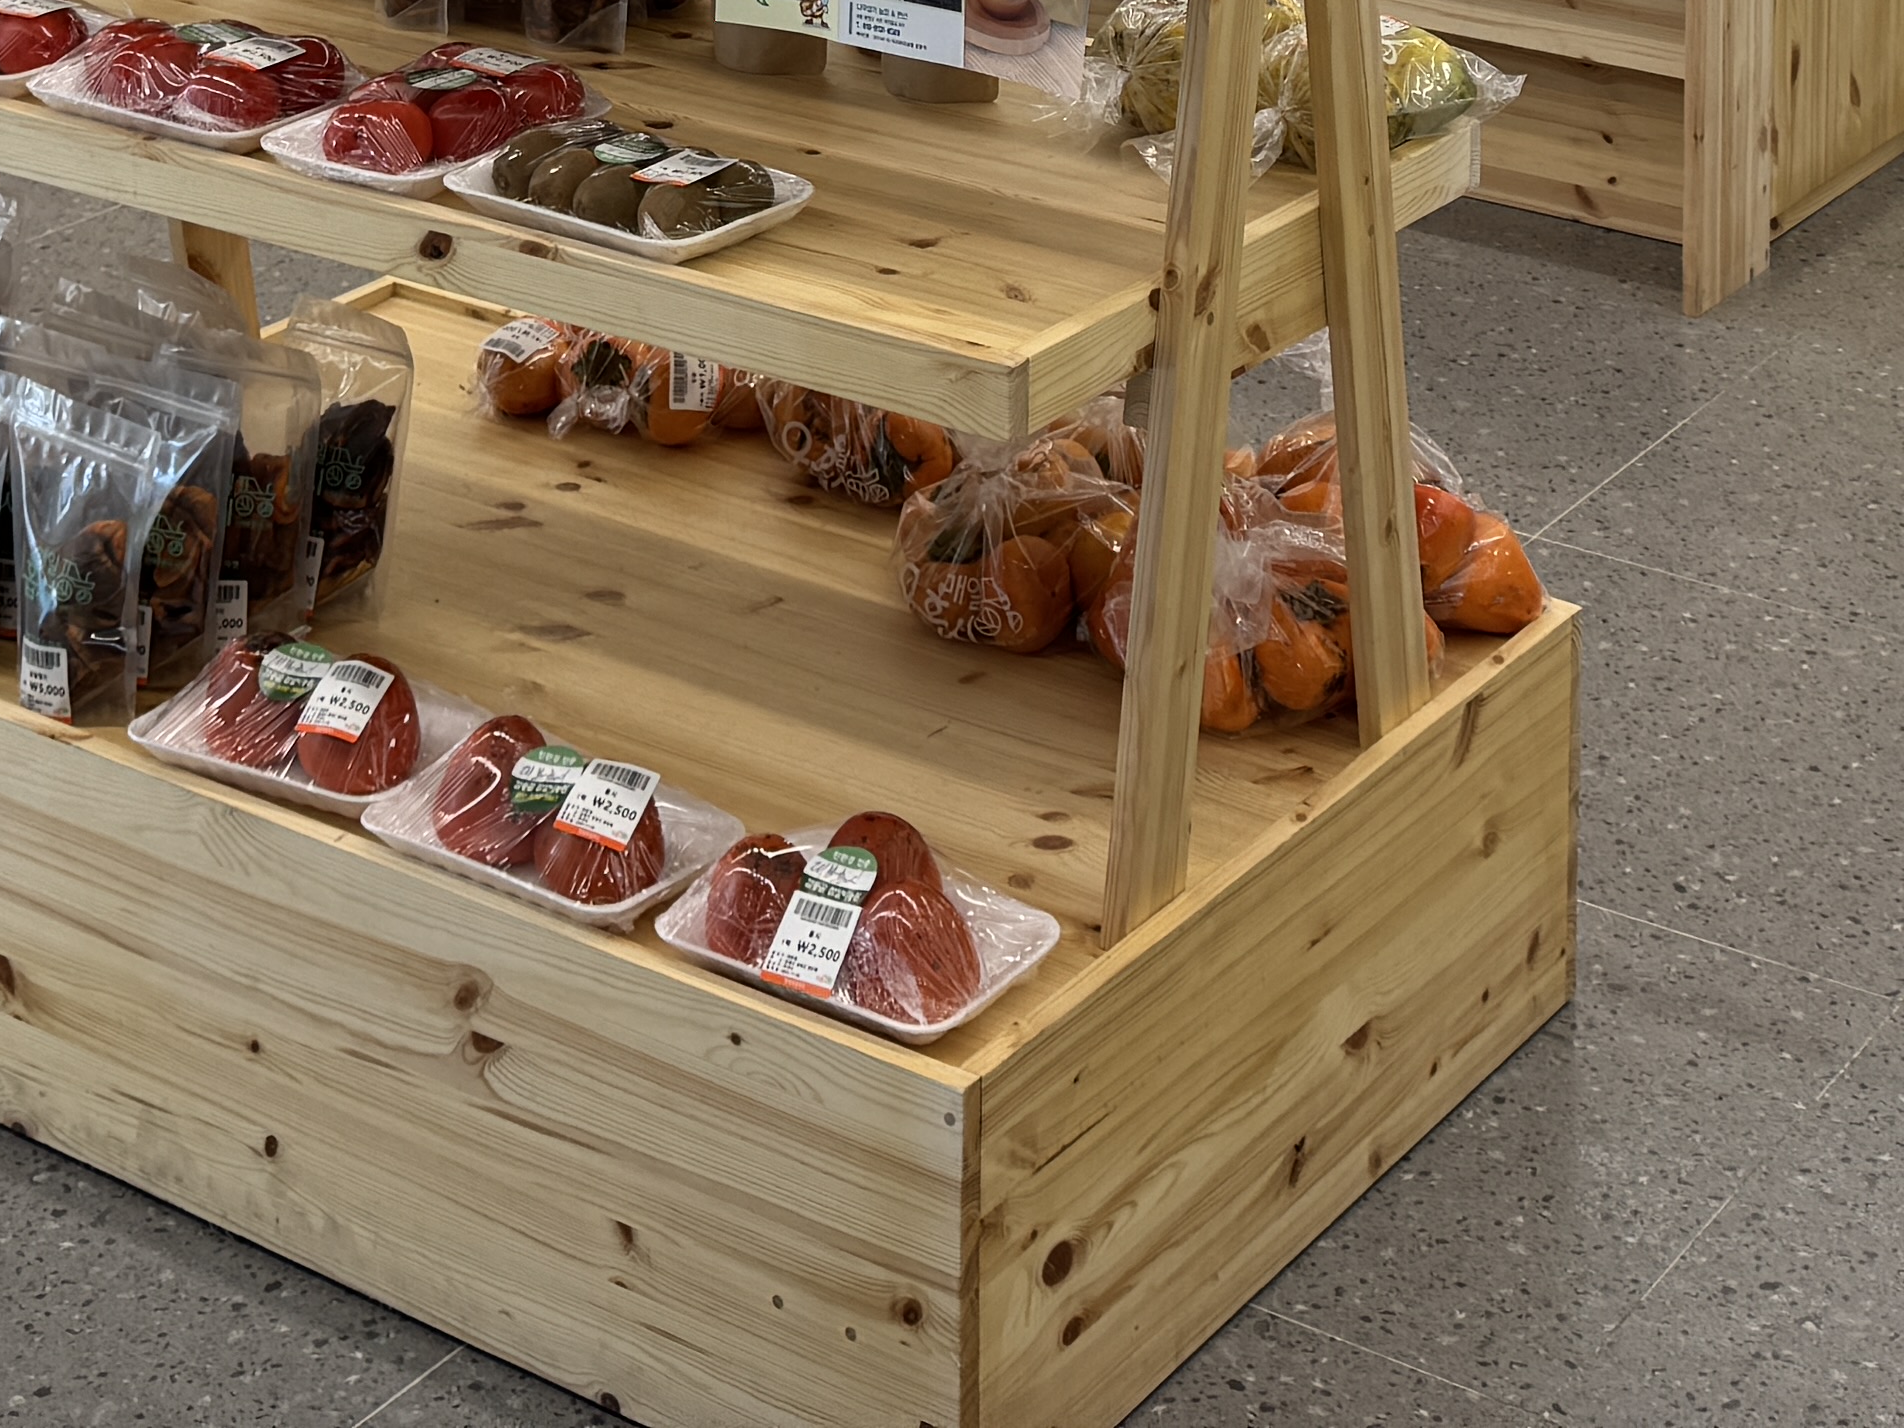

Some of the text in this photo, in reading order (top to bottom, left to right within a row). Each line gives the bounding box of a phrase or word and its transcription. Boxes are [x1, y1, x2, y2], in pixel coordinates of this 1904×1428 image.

[328, 694, 371, 716] ₩2,500
[592, 794, 638, 822] ₩2,500
[797, 939, 841, 963] ₩2,500
